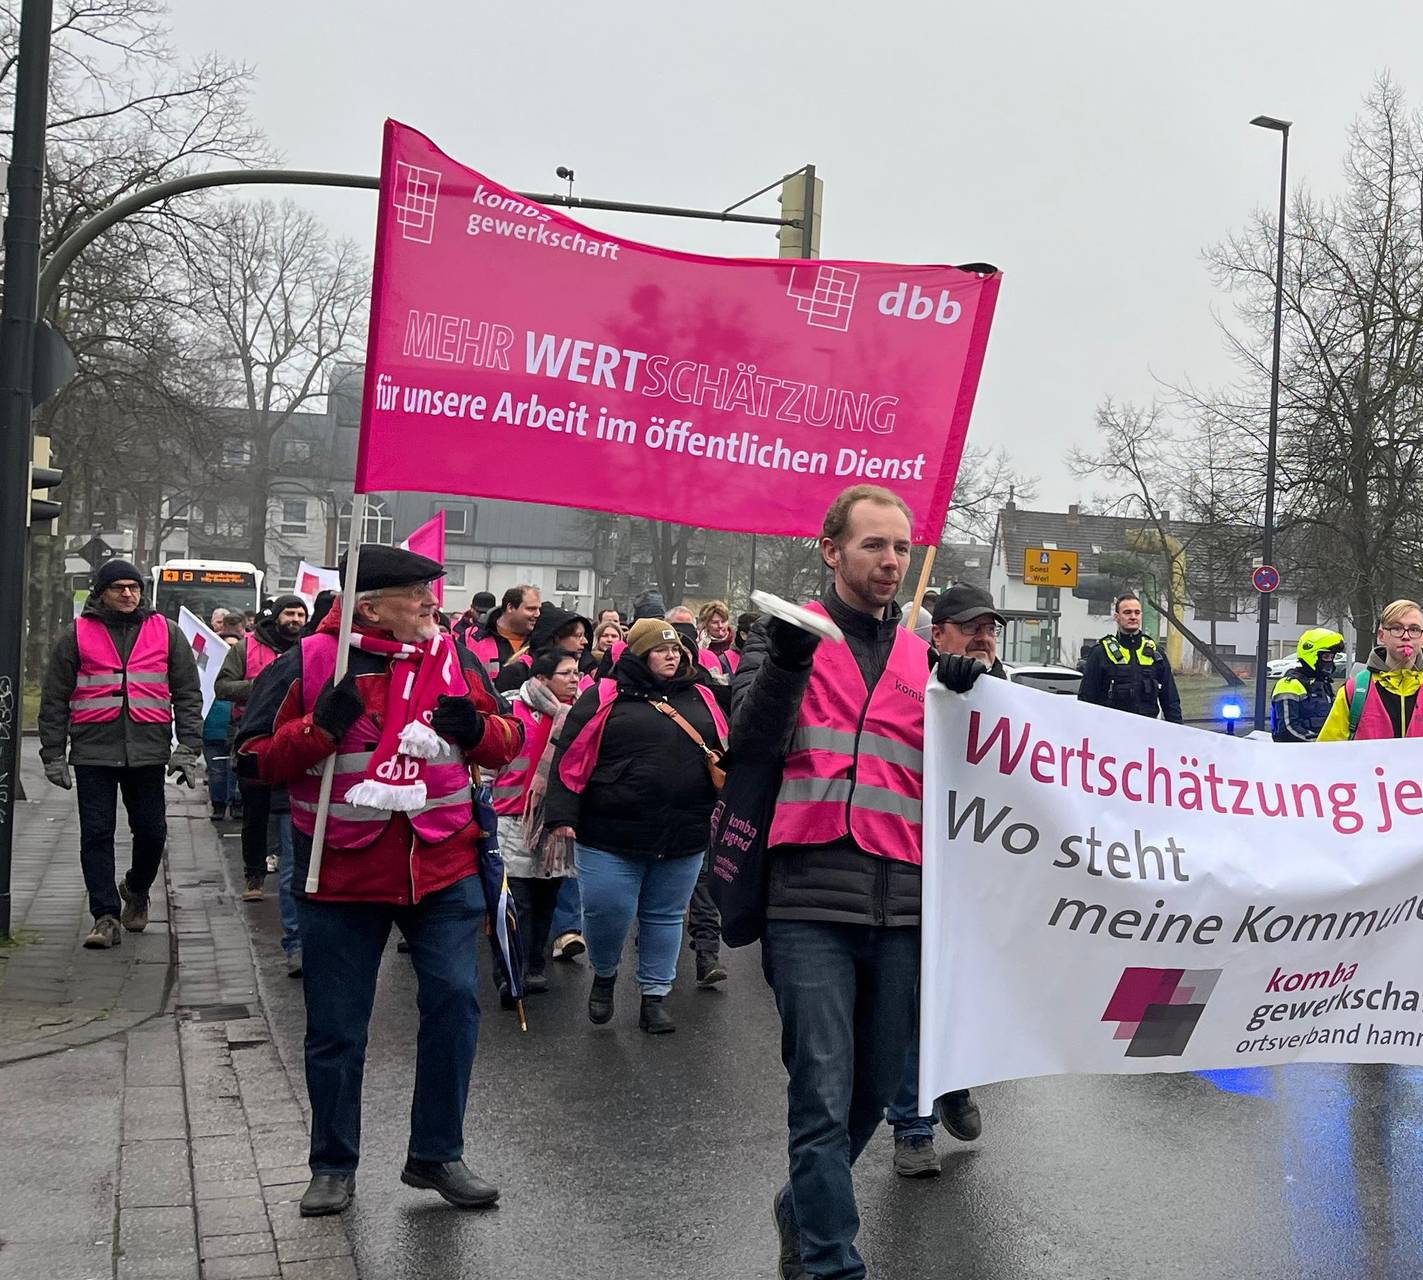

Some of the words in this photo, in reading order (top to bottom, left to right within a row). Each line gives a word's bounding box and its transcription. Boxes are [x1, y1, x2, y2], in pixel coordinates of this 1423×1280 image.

[472, 184, 553, 222] komba
[466, 213, 621, 261] gewerkschaft
[877, 281, 963, 325] dbb
[402, 309, 515, 371] MEHR
[525, 330, 900, 434] WERTSCHÄTZUNG
[375, 373, 401, 411] für
[403, 383, 487, 420] unsere
[491, 391, 589, 436] Arbeit
[595, 406, 637, 444] im
[645, 416, 827, 474] öffentlichen
[834, 448, 927, 481] Dienst
[894, 679, 924, 703] komb
[966, 710, 1364, 834] Wertschätzung
[721, 827, 752, 852] jugend
[728, 812, 757, 839] komba
[948, 790, 1040, 854] Wo
[1052, 826, 1190, 881] steht
[1048, 897, 1223, 945] meine
[1264, 962, 1359, 993] komba
[1235, 1023, 1361, 1054] ortsverband
